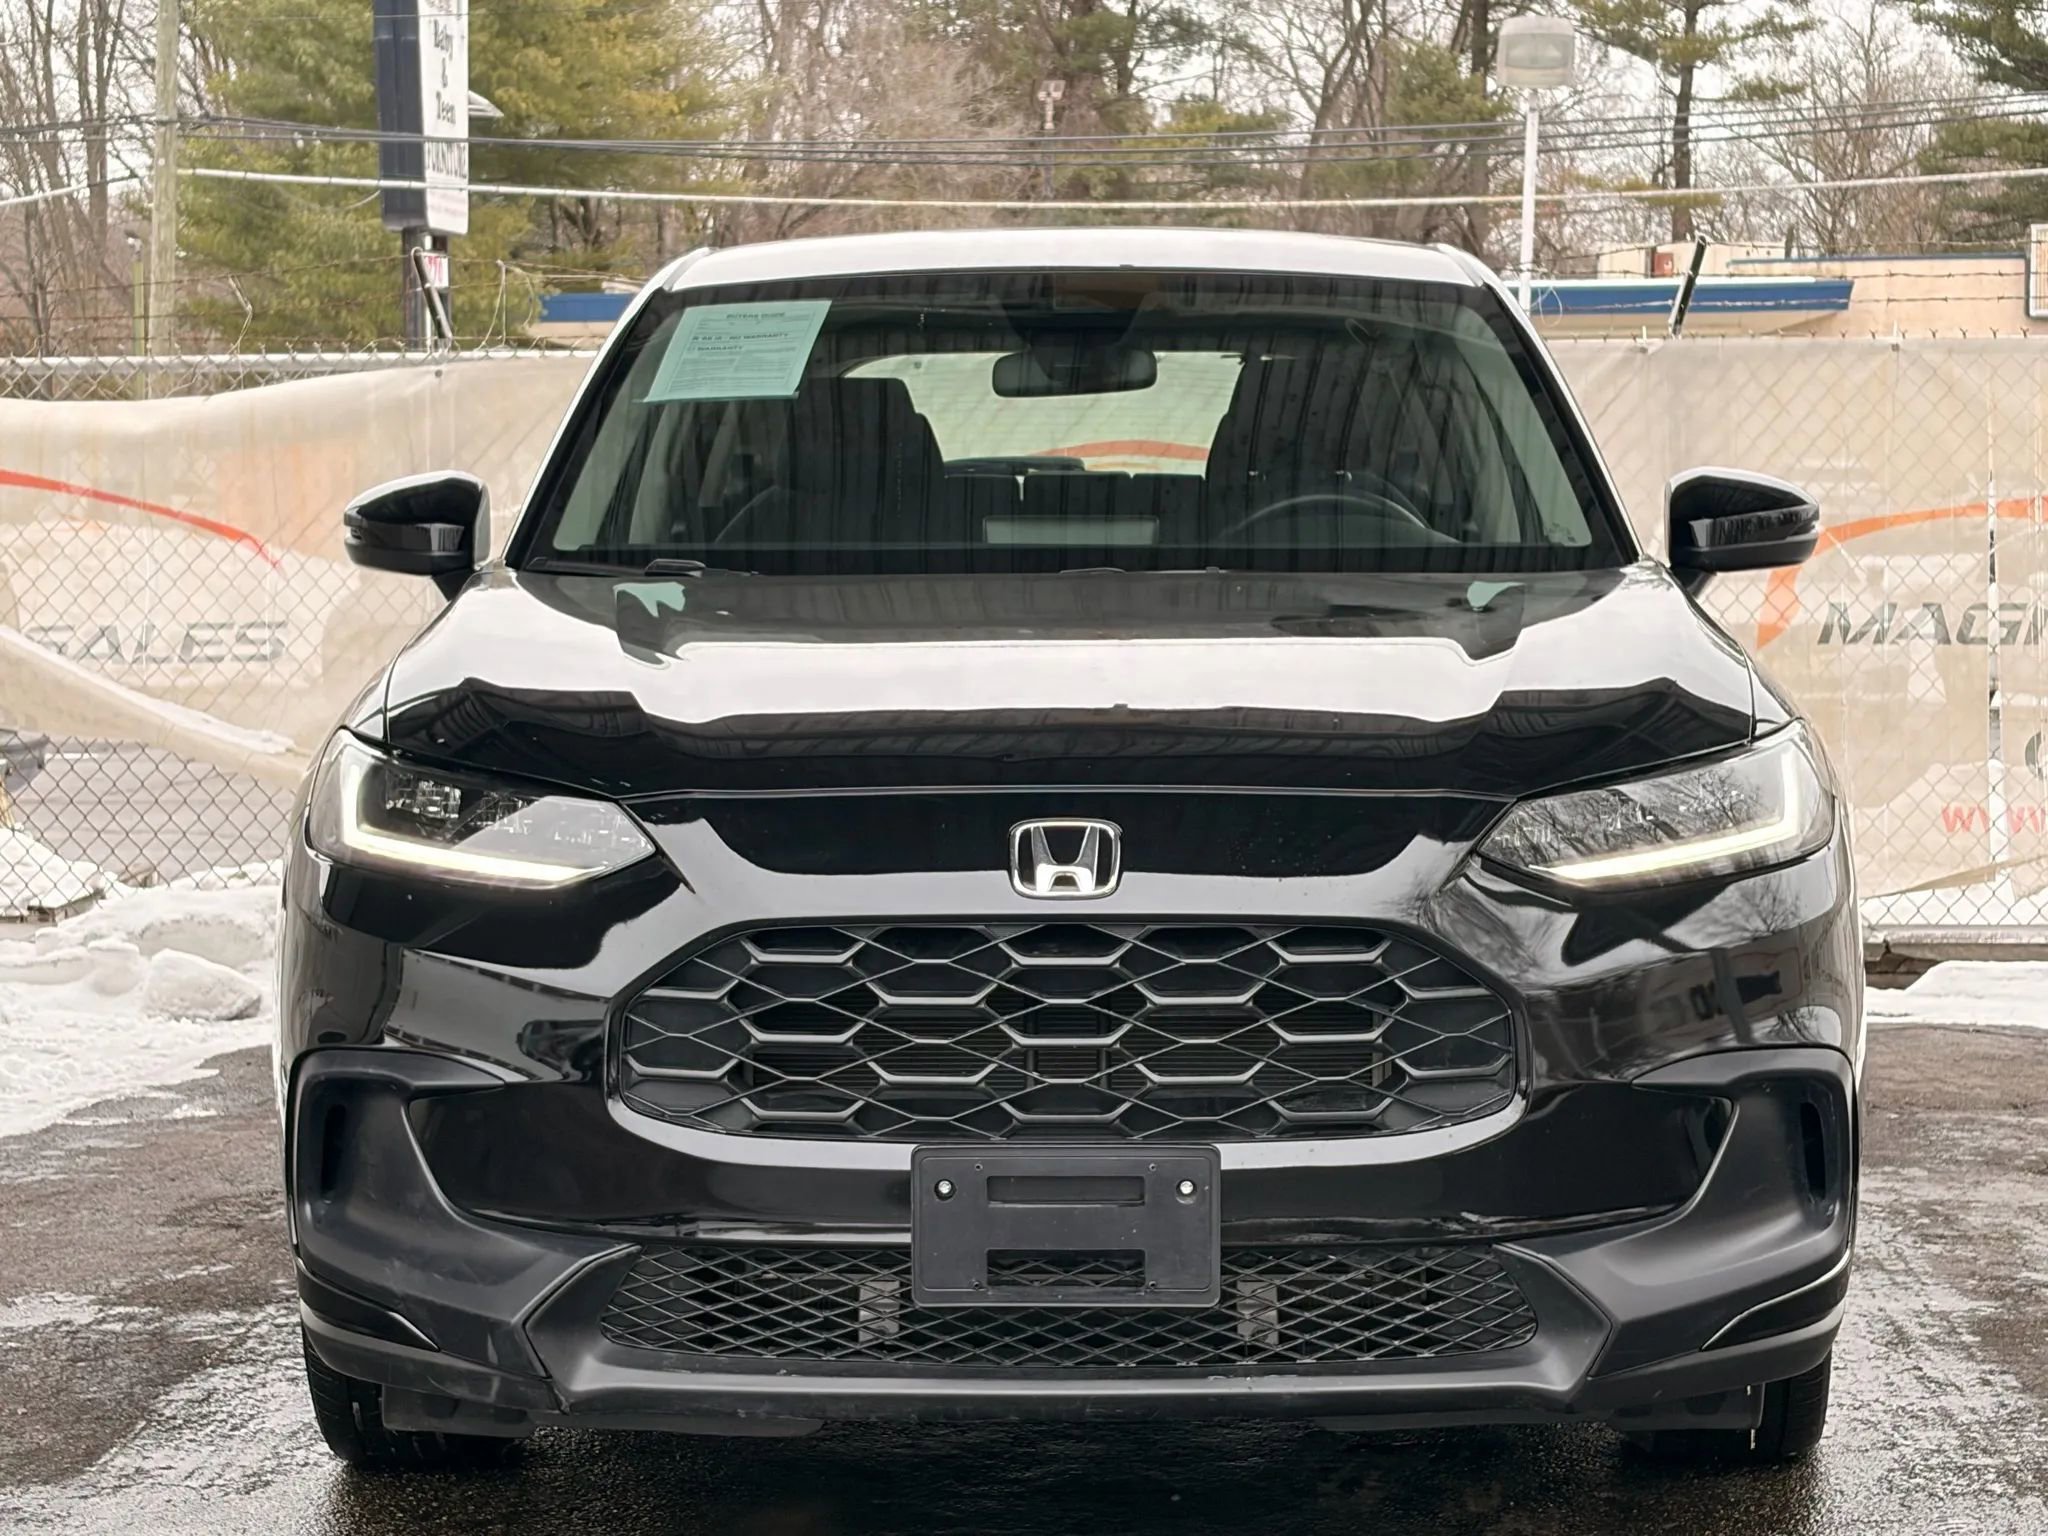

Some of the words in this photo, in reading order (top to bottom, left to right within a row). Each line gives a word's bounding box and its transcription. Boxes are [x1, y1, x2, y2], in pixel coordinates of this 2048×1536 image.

[433, 18, 453, 61] Baby
[436, 90, 456, 125] Teen
[25, 621, 288, 664] SALES
